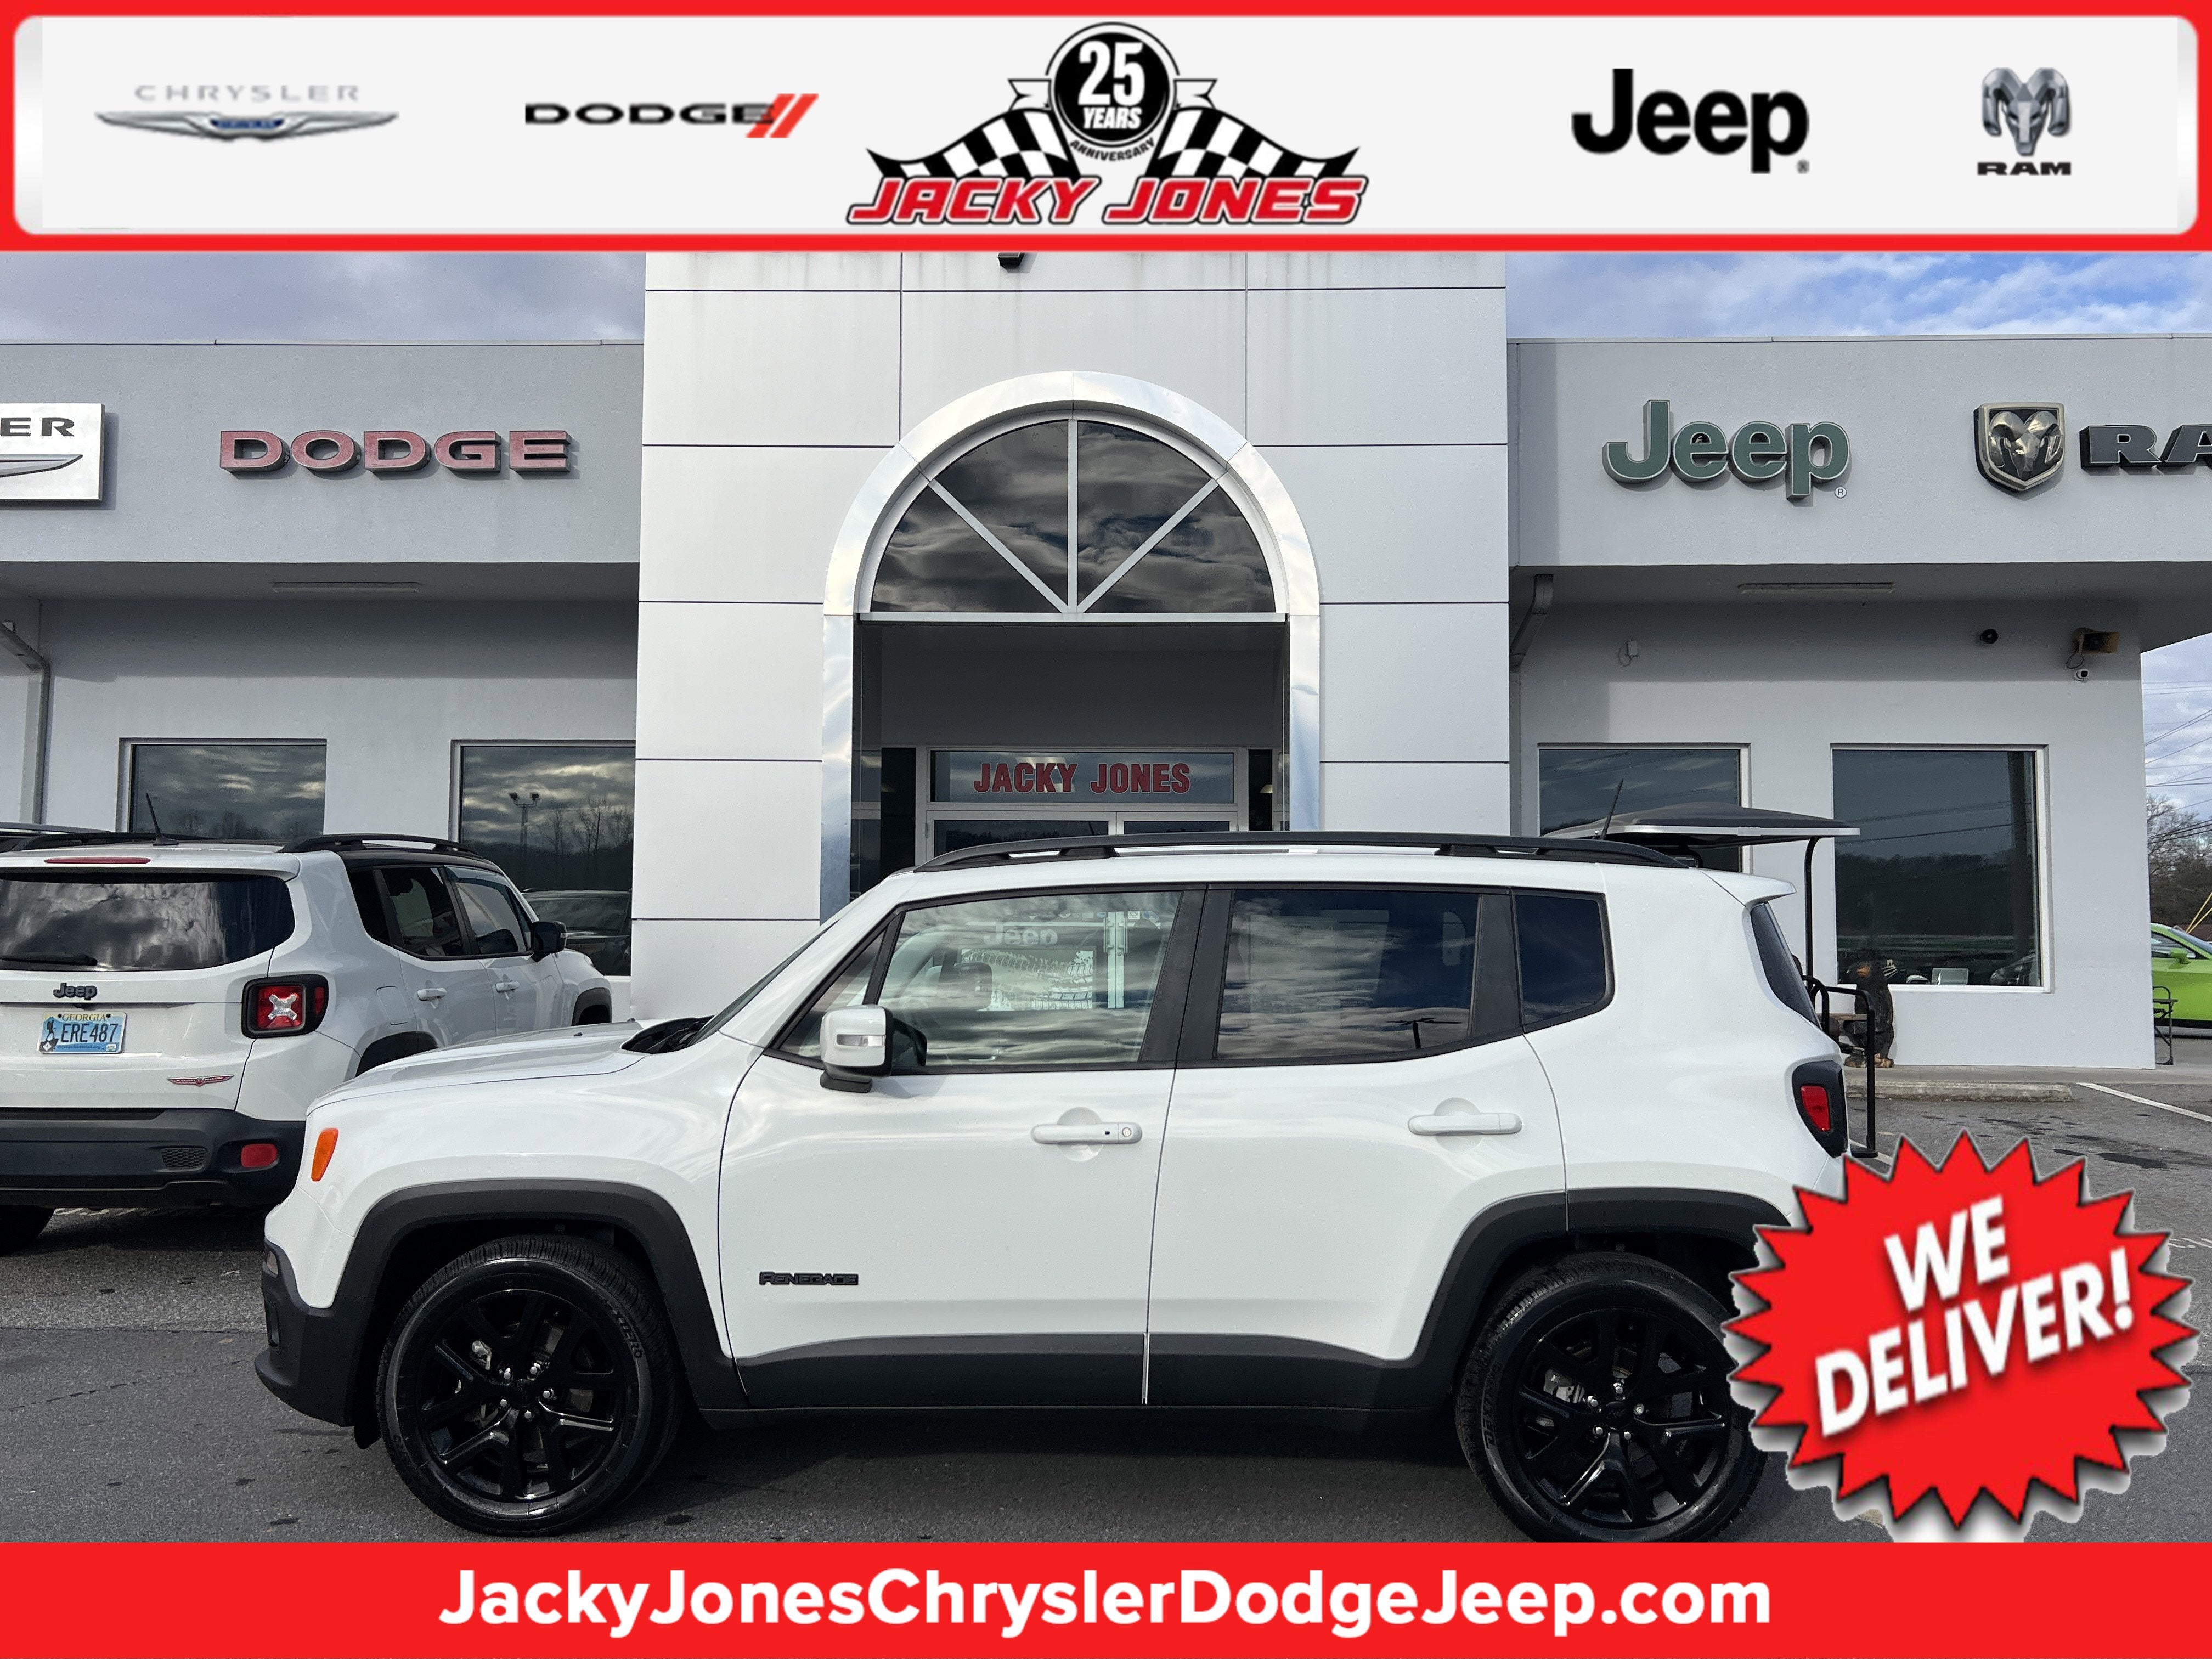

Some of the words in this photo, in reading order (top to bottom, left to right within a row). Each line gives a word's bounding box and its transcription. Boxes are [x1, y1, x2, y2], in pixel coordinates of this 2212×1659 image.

[0, 417, 75, 437] ER
[220, 431, 571, 472] DODGE
[1602, 399, 1851, 500] Jeep
[974, 762, 1079, 793] JACKY
[1091, 762, 1192, 794] JONES
[53, 983, 97, 1000] Jeep
[62, 1013, 106, 1022] GEORGIA
[61, 1023, 119, 1043] ERE487
[759, 1272, 859, 1286] RENEGADE
